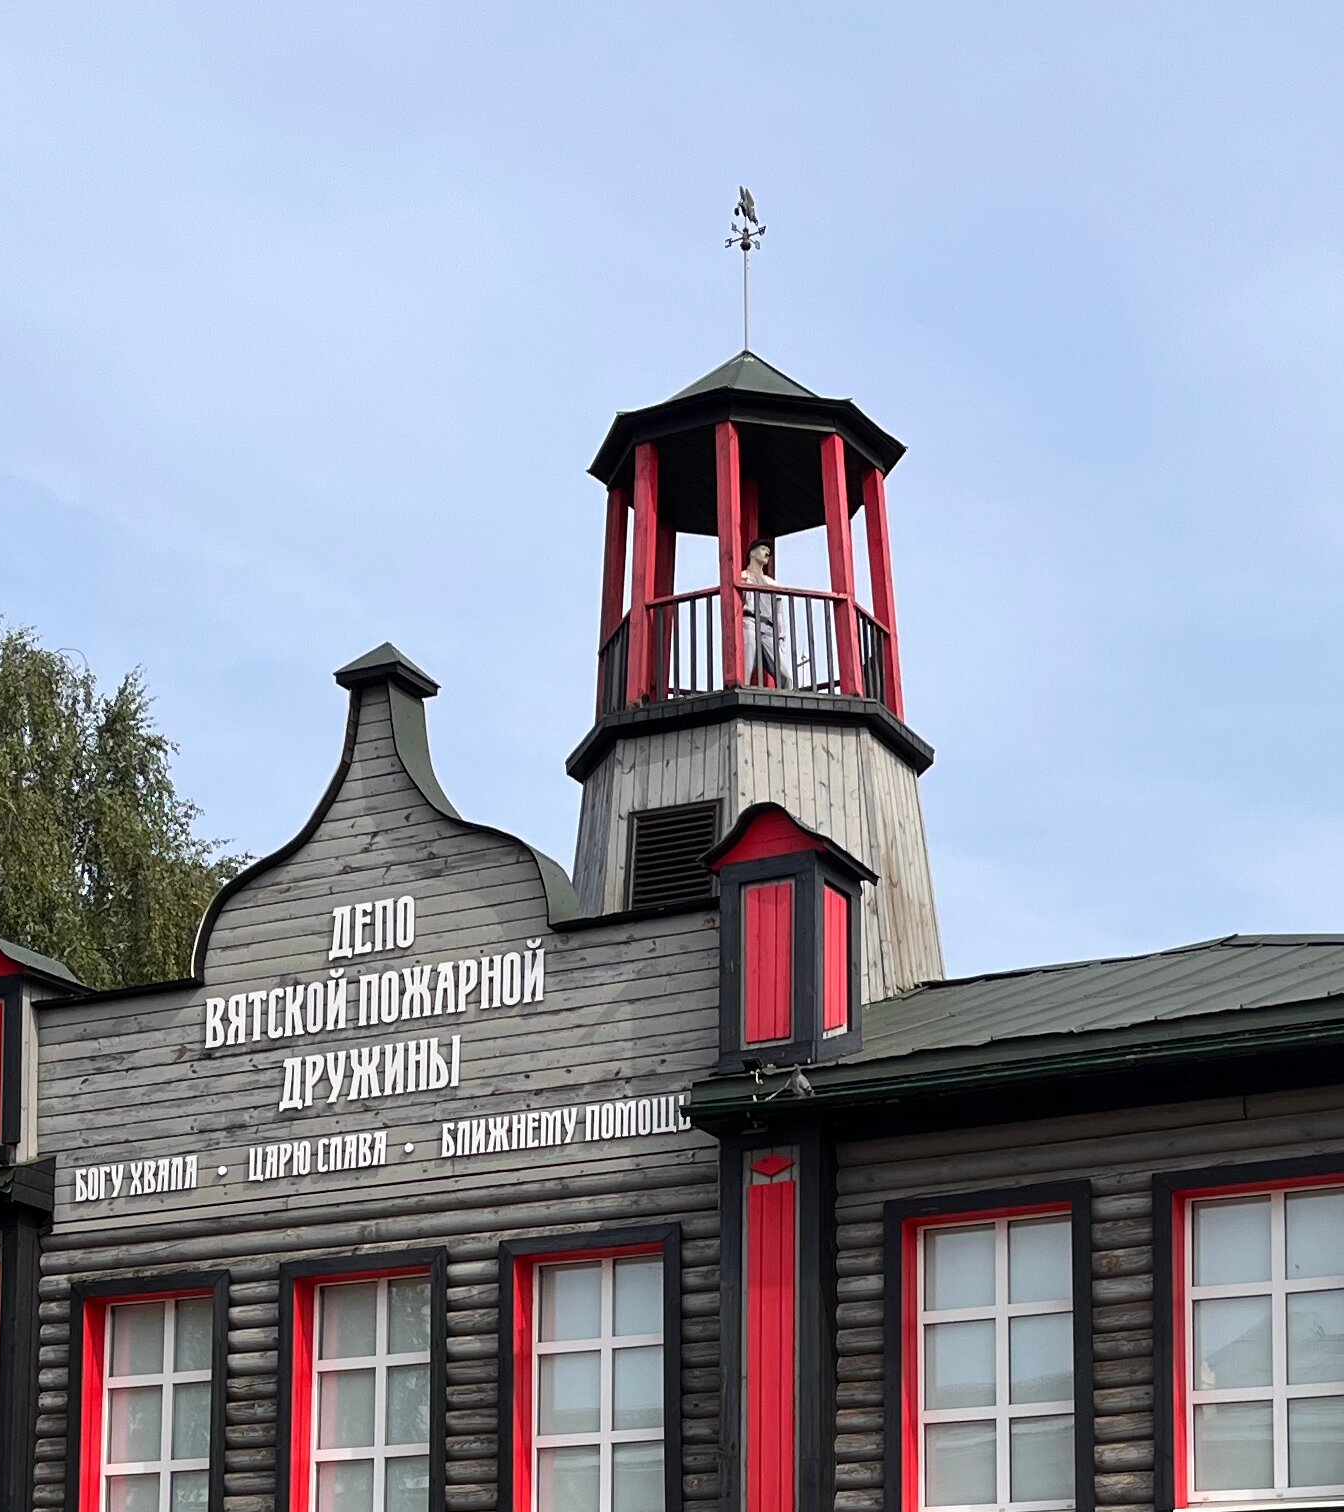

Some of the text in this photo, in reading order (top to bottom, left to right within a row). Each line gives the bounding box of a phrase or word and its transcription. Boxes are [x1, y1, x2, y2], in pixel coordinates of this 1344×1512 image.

[328, 895, 416, 961] ДЕПО
[204, 938, 546, 1049] ВЯТСКОЙ ПОЖАРНОЙ
[278, 1035, 462, 1112] ДРУЖИНЫ
[74, 1163, 124, 1202] БОГУ
[129, 1154, 199, 1196] ХВАЛА
[248, 1140, 312, 1182] ЦАРЮ
[316, 1130, 388, 1173] СЛАВА
[441, 1108, 578, 1158] БЛИЖНЕМУ
